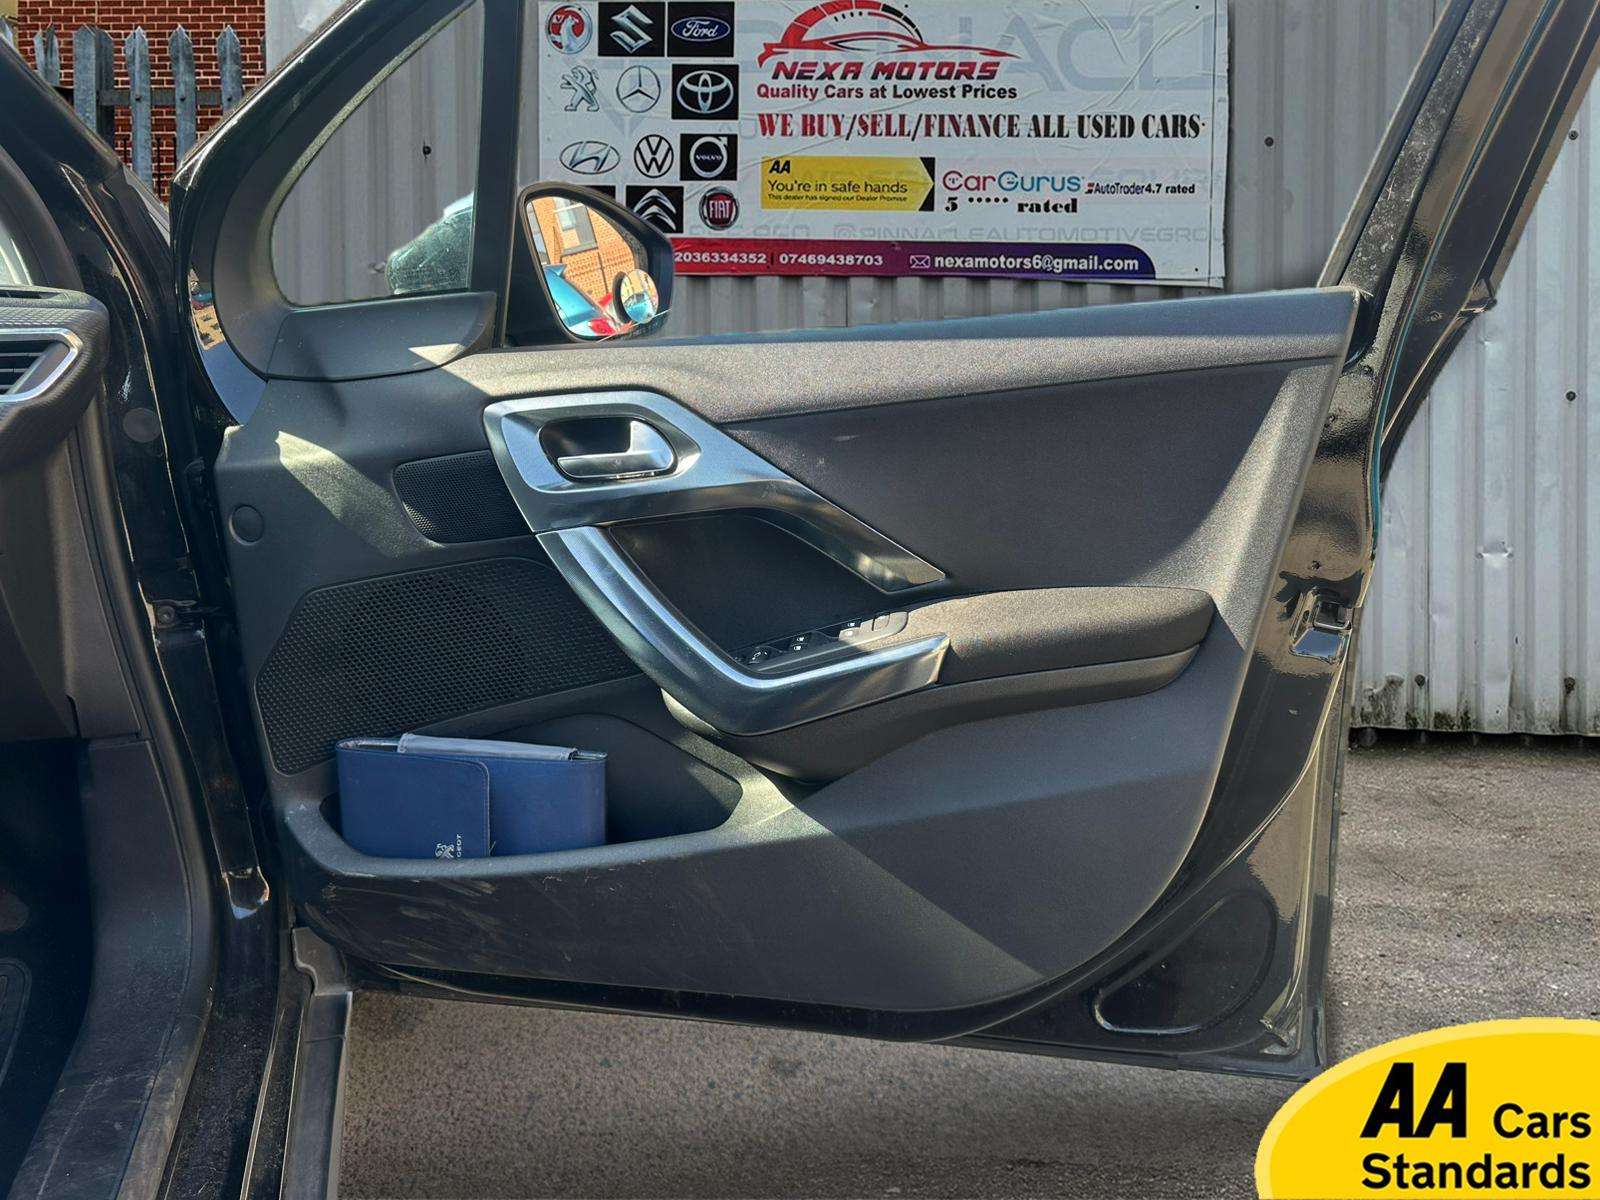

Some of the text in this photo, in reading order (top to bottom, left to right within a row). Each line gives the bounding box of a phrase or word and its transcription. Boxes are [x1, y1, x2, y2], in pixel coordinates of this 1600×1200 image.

[682, 20, 718, 37] Ford
[772, 61, 1000, 80] NEXA MOTORS
[757, 84, 1017, 101] Quality Cars at Lowest Prices
[758, 113, 793, 137] WE
[1028, 114, 1069, 138] ALL
[1077, 114, 1135, 139] USED
[1142, 114, 1200, 139] CARS
[769, 160, 791, 174] AA
[768, 180, 908, 193] You're in safe hands
[942, 170, 1081, 192] CarGurus
[1165, 183, 1195, 194] rated
[819, 194, 841, 202] signed
[945, 197, 1078, 213] 5 rated
[709, 200, 731, 219] FIAT
[673, 251, 883, 266] 2036334352 07469438703
[934, 255, 1139, 273] nexamotors6@gmail.com
